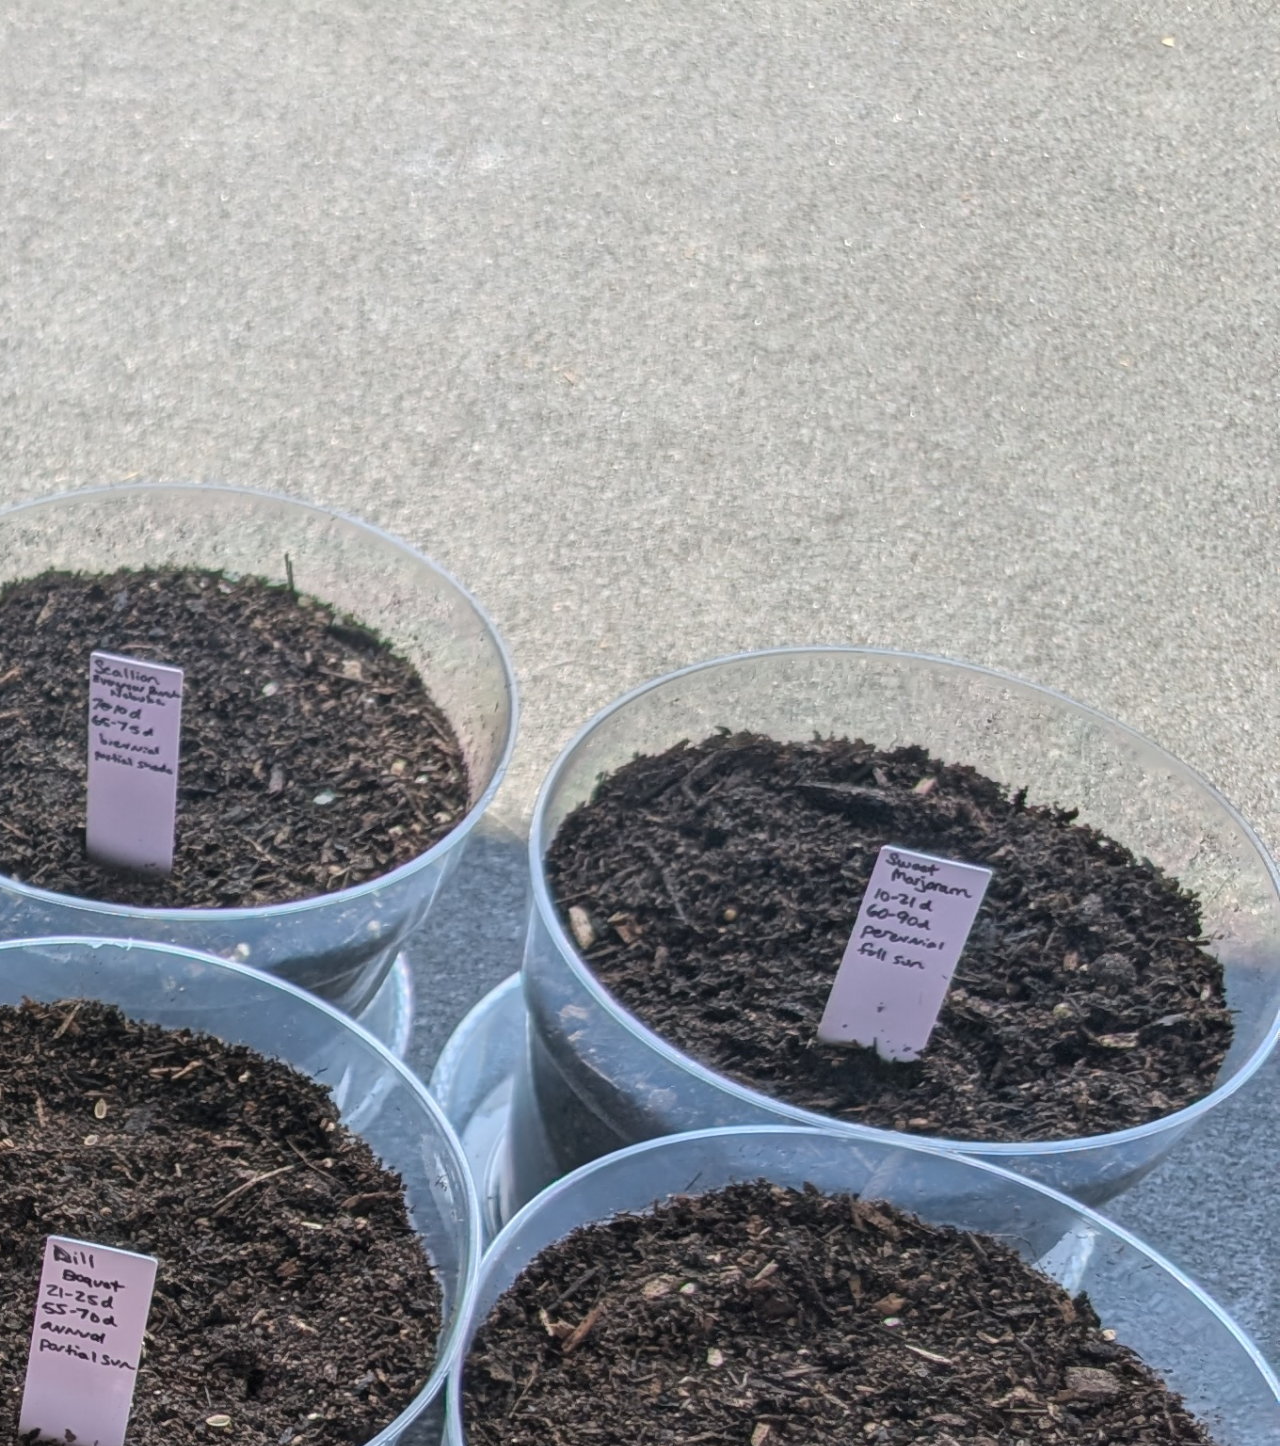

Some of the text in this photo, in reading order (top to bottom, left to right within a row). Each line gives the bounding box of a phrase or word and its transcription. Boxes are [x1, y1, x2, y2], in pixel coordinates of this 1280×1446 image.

[94, 659, 160, 686] Scallion
[885, 852, 940, 876] Sweet
[53, 1244, 95, 1269] Dill
[45, 1284, 99, 1306] 21-25
[41, 1301, 100, 1323] 55-70
[40, 1321, 106, 1344] annual
